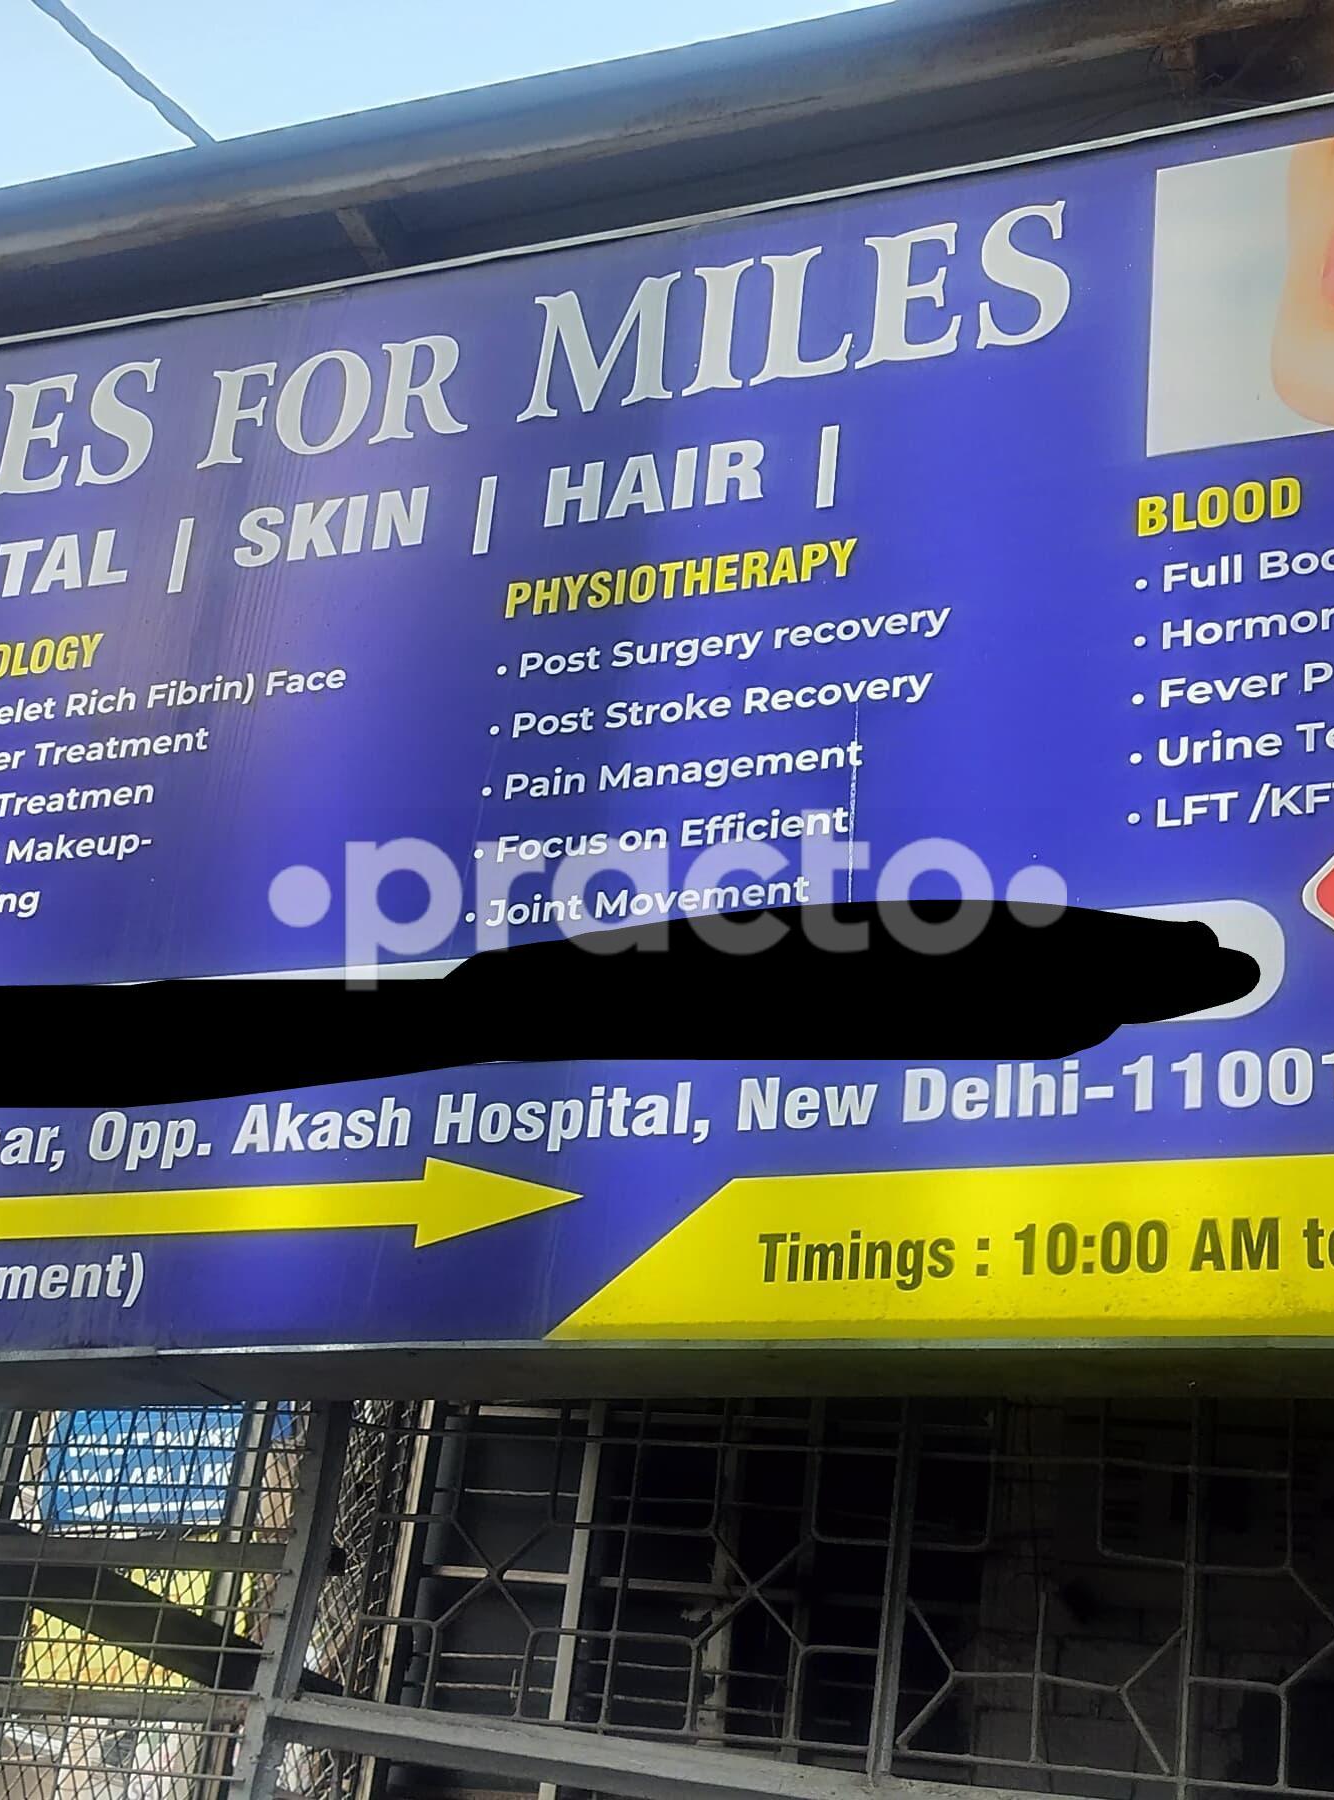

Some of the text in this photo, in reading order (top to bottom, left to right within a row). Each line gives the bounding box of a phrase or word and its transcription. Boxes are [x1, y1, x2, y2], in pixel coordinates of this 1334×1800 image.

[196, 335, 469, 470] FOR
[516, 200, 1071, 423] MILES
[233, 485, 430, 568] SKIN
[543, 439, 765, 528] HAIR
[1137, 477, 1301, 537] BLOOD
[504, 538, 858, 618] PHYSIOTHERAPY
[1163, 553, 1242, 593] Full
[519, 607, 952, 678] Post Surgery recovery
[65, 686, 136, 718] Rich
[146, 672, 255, 709] Fibrin)
[265, 669, 347, 696] Face
[511, 672, 933, 739] Post Stroke Recovery
[1160, 671, 1288, 708] Fever
[34, 727, 209, 767] Treatment
[504, 739, 863, 801] Pain Management
[1158, 729, 1283, 767] Urine
[494, 805, 849, 864] Focus on Efficient
[1156, 791, 1239, 828] LFT
[5, 833, 152, 865] Makeup-
[486, 875, 810, 928] Joint Movement
[88, 1111, 212, 1171] Opp.
[230, 1097, 411, 1155] Akash
[433, 1081, 710, 1152] Hospital,
[736, 1076, 879, 1132] New
[758, 1229, 956, 1291] Timings
[1014, 1219, 1168, 1276] 10:00
[1189, 1216, 1280, 1272] AM
